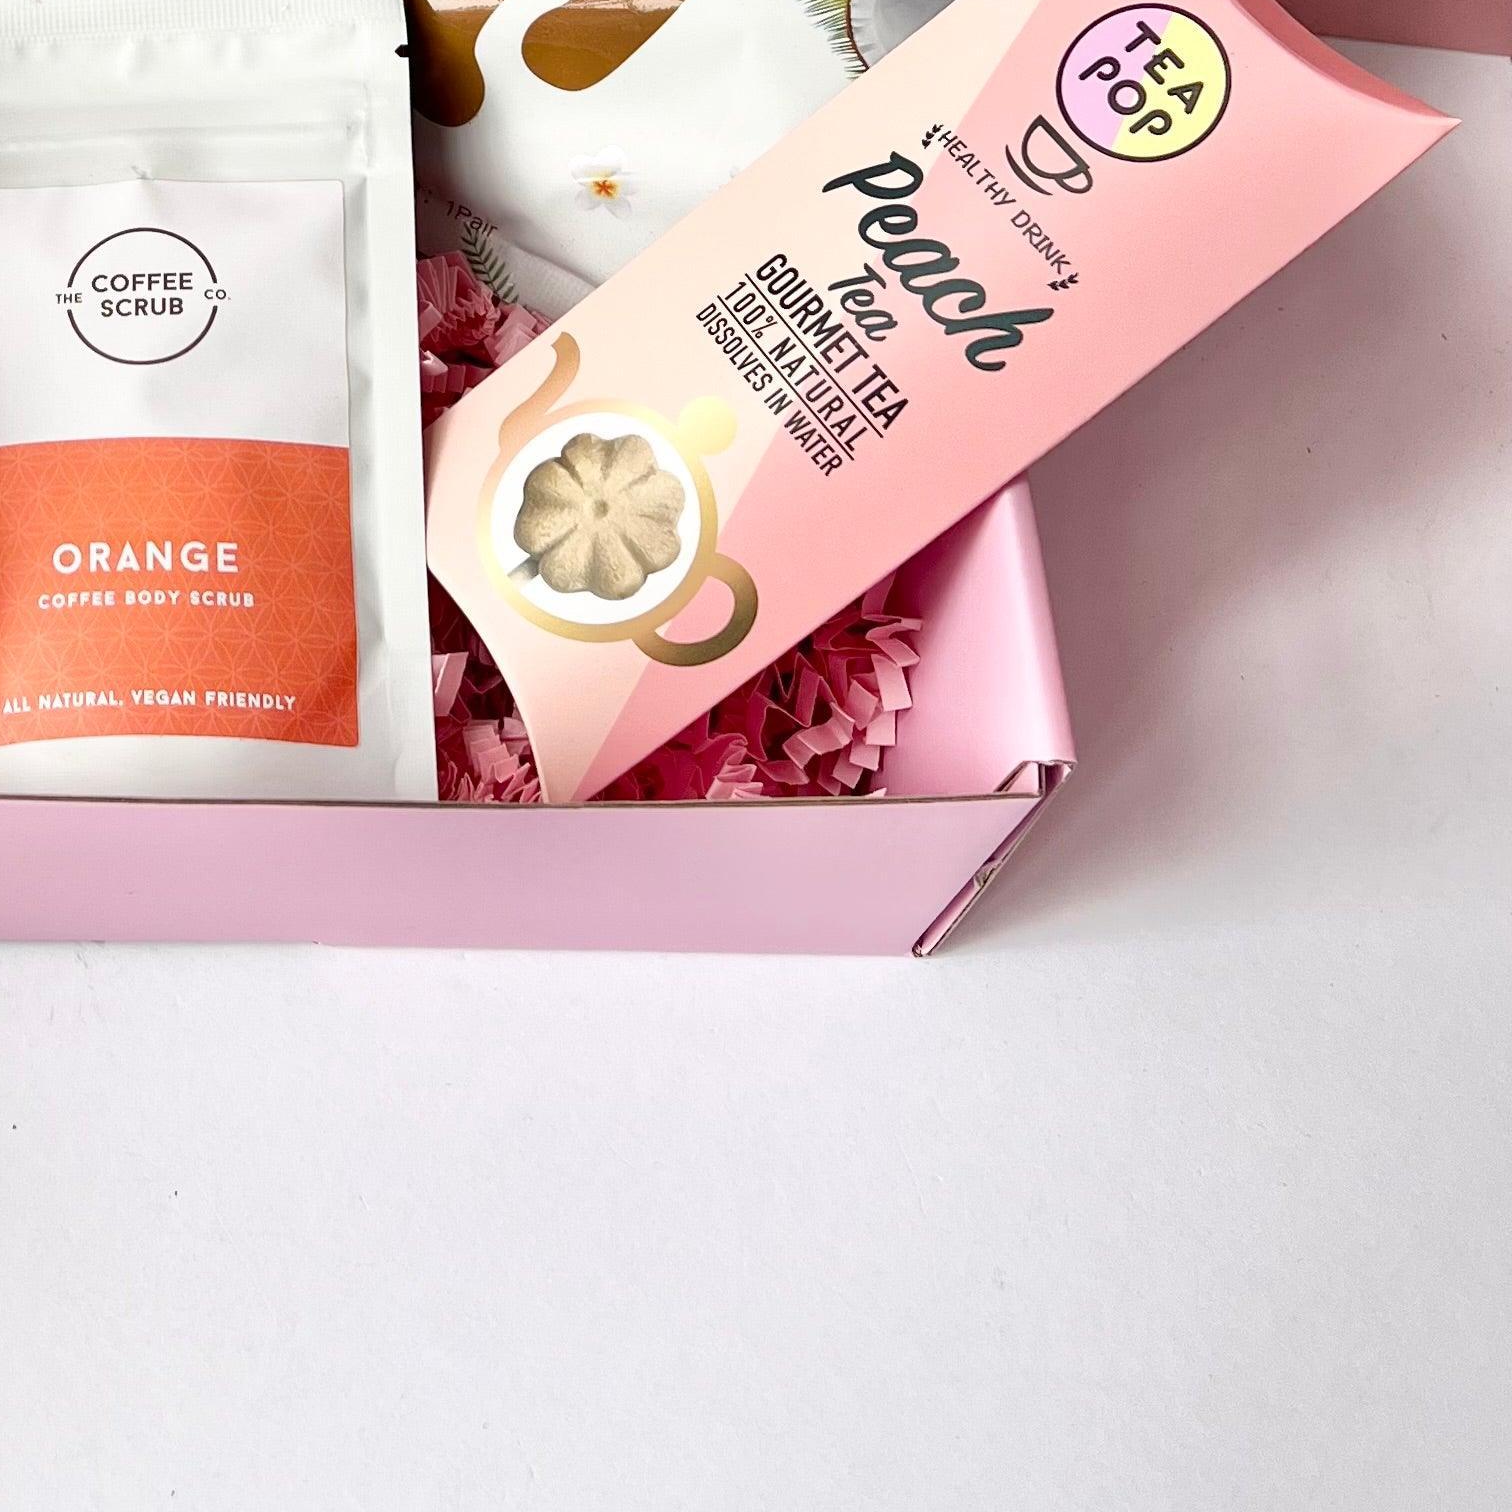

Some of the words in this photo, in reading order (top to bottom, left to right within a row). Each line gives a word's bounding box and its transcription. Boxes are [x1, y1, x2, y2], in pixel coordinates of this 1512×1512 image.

[1078, 56, 1173, 138] POP
[1124, 20, 1204, 116] TEA
[938, 130, 1016, 208] HEALTHY
[1010, 209, 1071, 277] DRINK
[91, 272, 193, 293] COFFEE
[821, 150, 1055, 373] Peach
[828, 262, 898, 342] Tea
[55, 293, 83, 304] THE
[100, 297, 184, 317] SCRUB
[756, 253, 870, 374] GOURMET
[851, 364, 909, 430] TEA
[695, 302, 773, 392] DISSOLVES
[764, 387, 793, 416] IN
[784, 409, 843, 477] WATER
[724, 281, 778, 339] 100%
[768, 336, 868, 452] NATURAL
[52, 540, 240, 575] ORANGE
[38, 590, 116, 610] COFFEE
[124, 589, 181, 606] BODY
[189, 591, 255, 608] SCRUB
[2, 697, 31, 714] ALL
[130, 689, 197, 706] VEGAN
[204, 690, 296, 711] FRIENDLY
